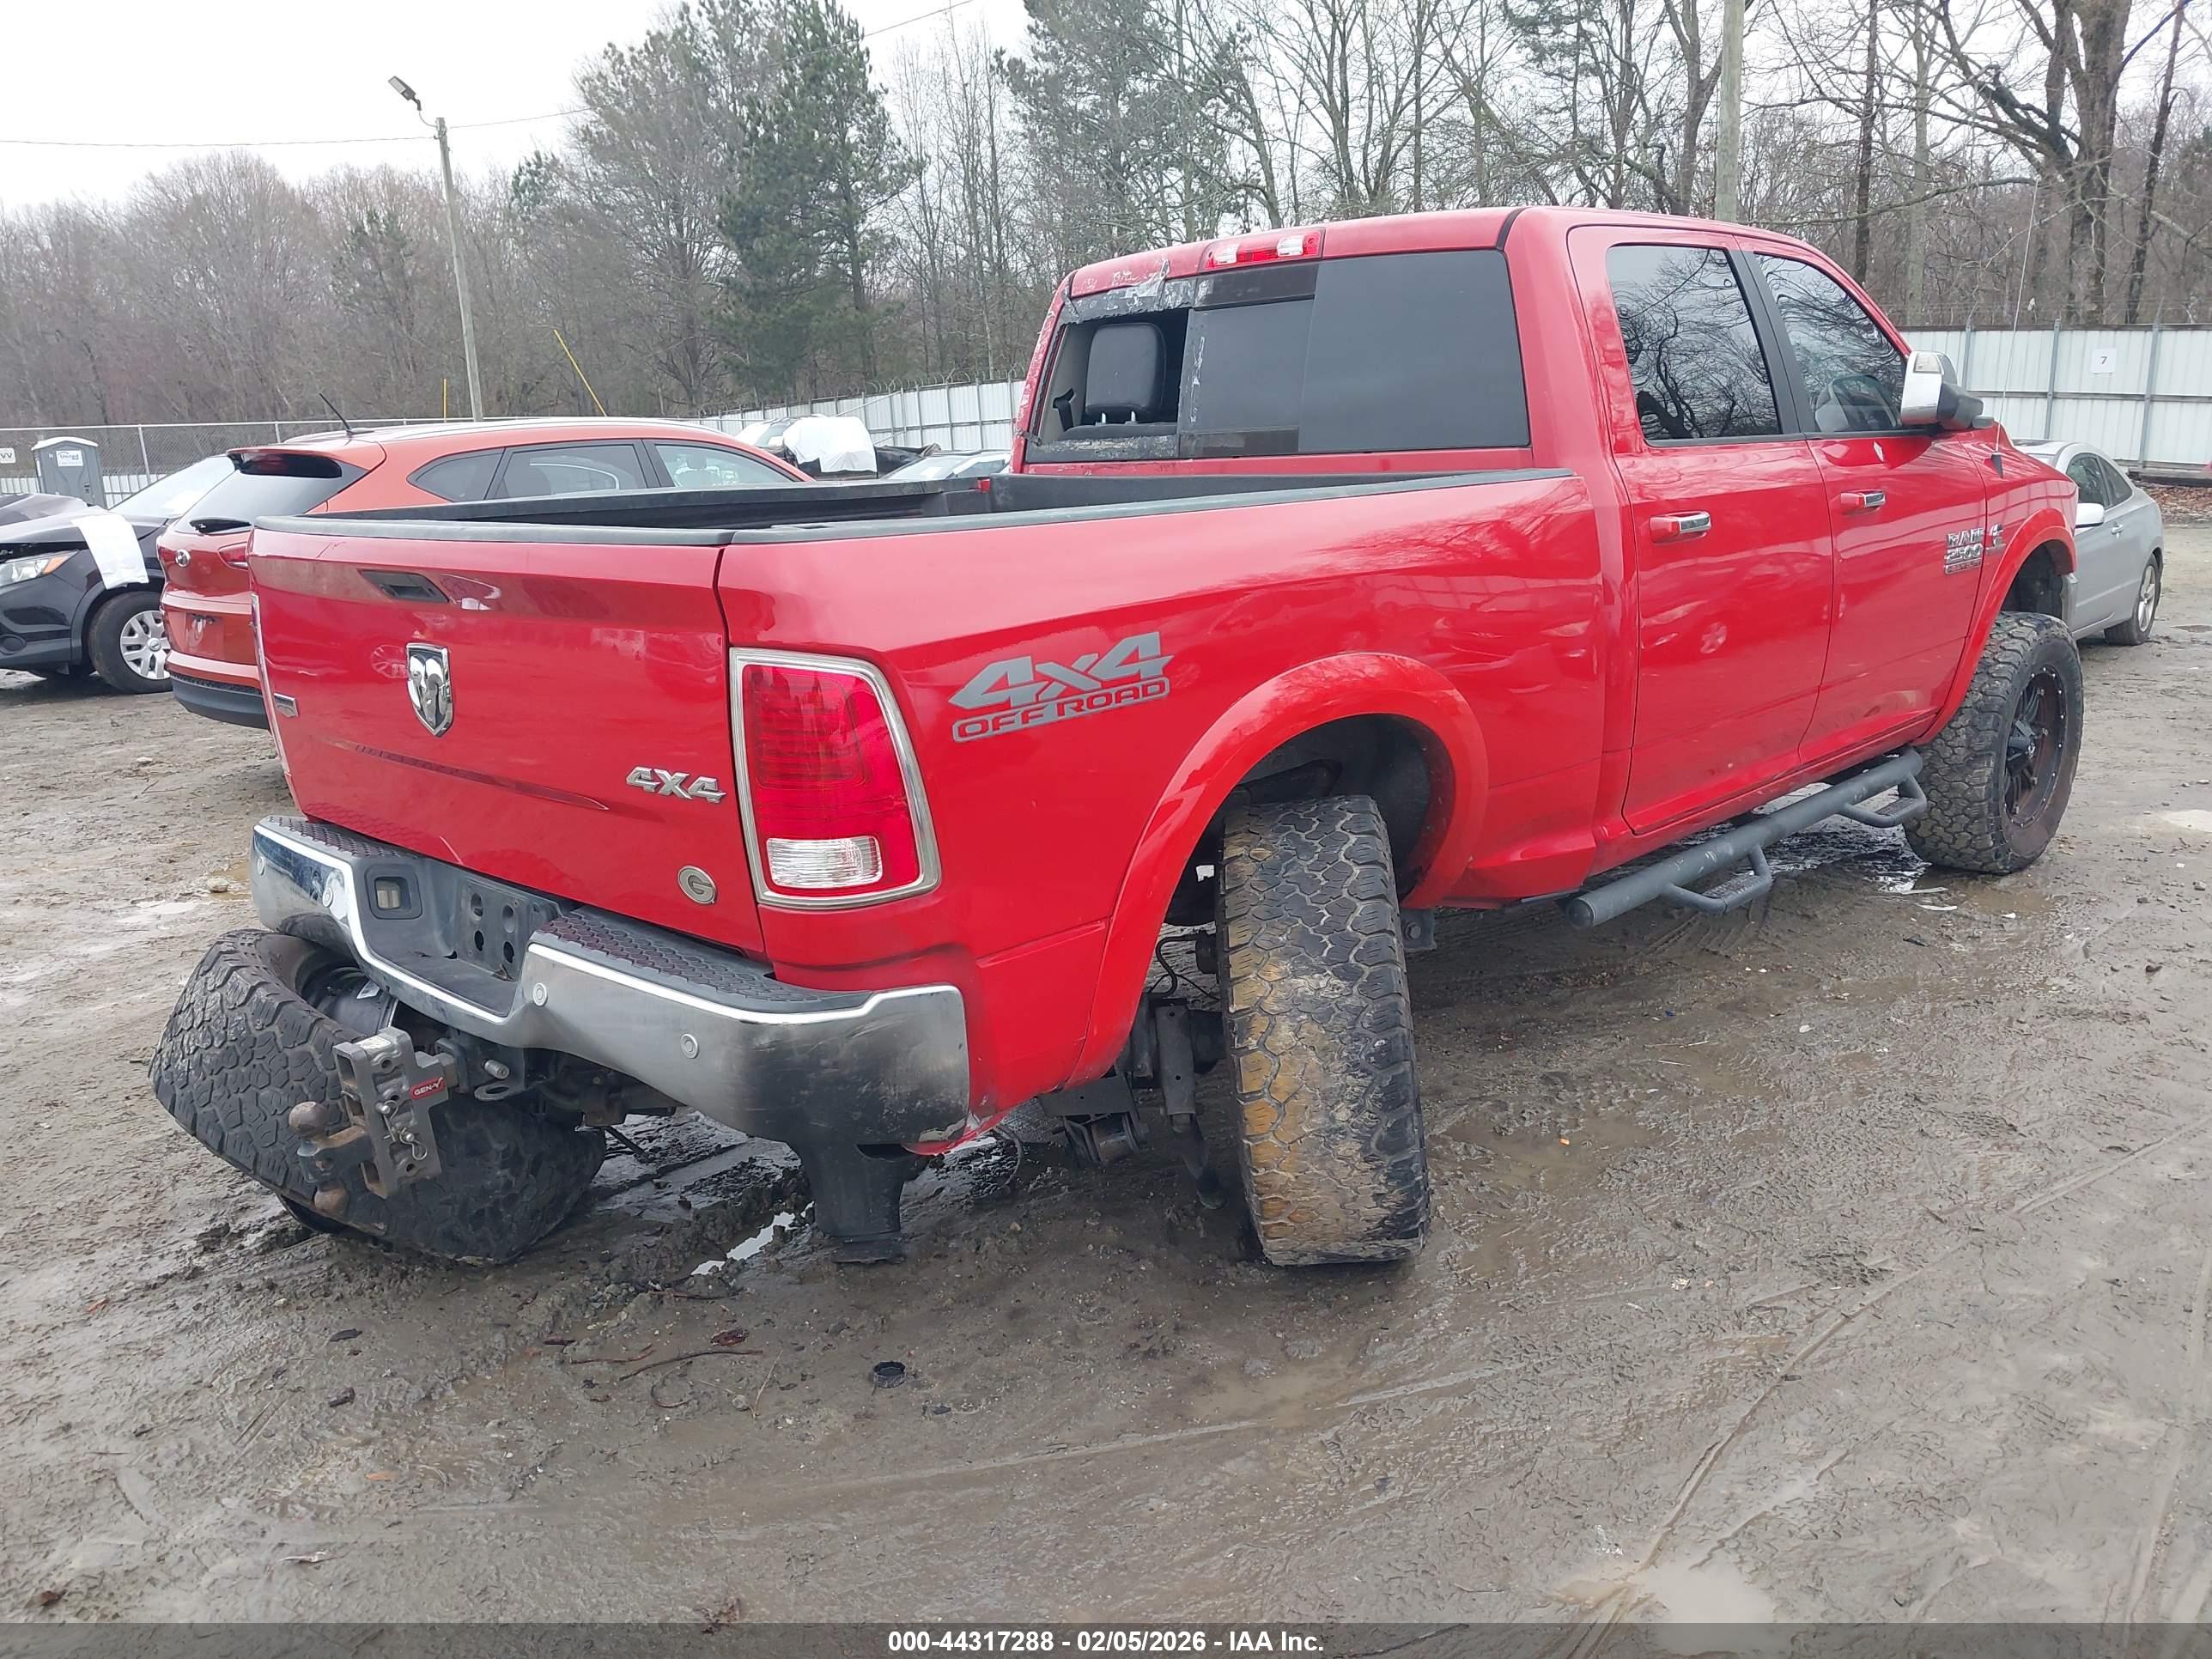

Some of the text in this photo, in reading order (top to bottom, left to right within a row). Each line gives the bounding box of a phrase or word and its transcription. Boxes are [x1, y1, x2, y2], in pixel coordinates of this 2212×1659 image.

[2100, 356, 2108, 365] 7
[957, 678, 1166, 738] OFF ROAD
[414, 1077, 443, 1096] GEN-Y
